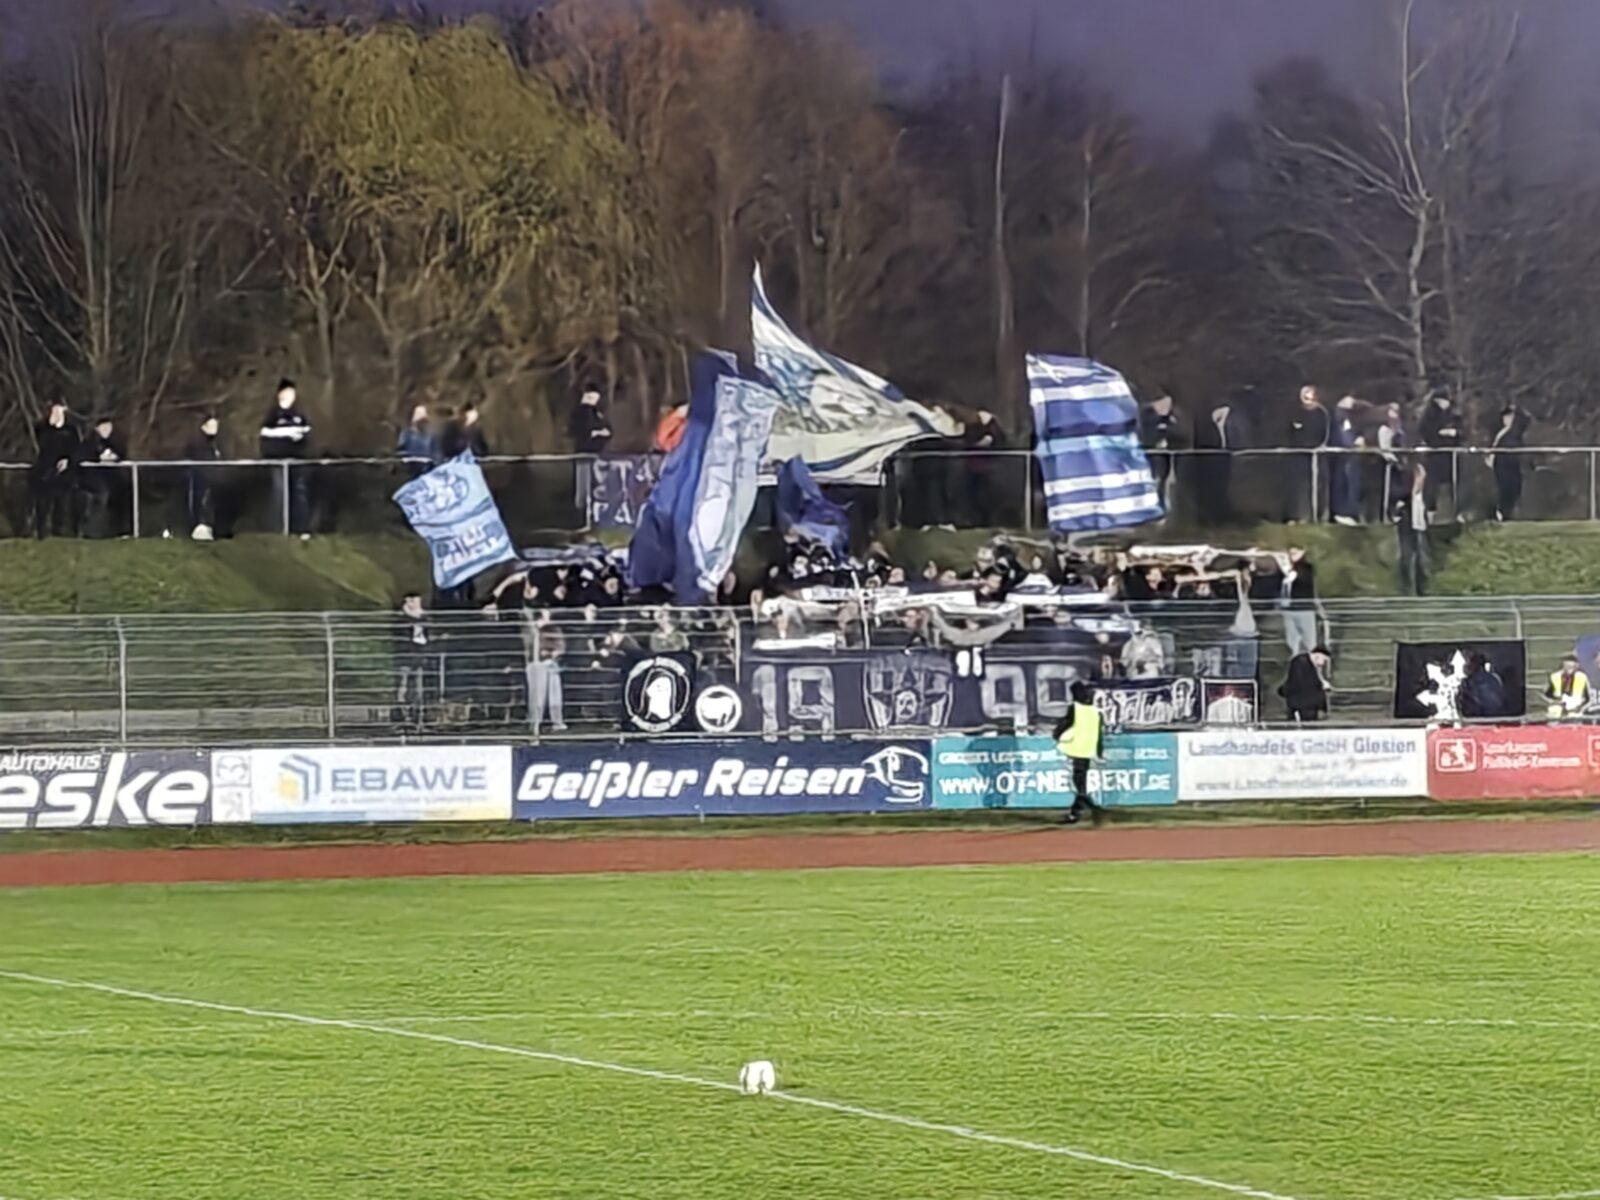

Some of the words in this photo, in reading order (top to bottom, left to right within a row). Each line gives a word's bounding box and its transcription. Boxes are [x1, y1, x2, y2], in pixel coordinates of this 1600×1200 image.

[0, 753, 100, 774] AUTOHAUS
[0, 751, 210, 826] eske
[330, 765, 488, 792] EBAWE
[516, 757, 699, 808] Geißler
[703, 755, 868, 798] Reisen
[938, 768, 1172, 796] www.OT-NEBERT.DE
